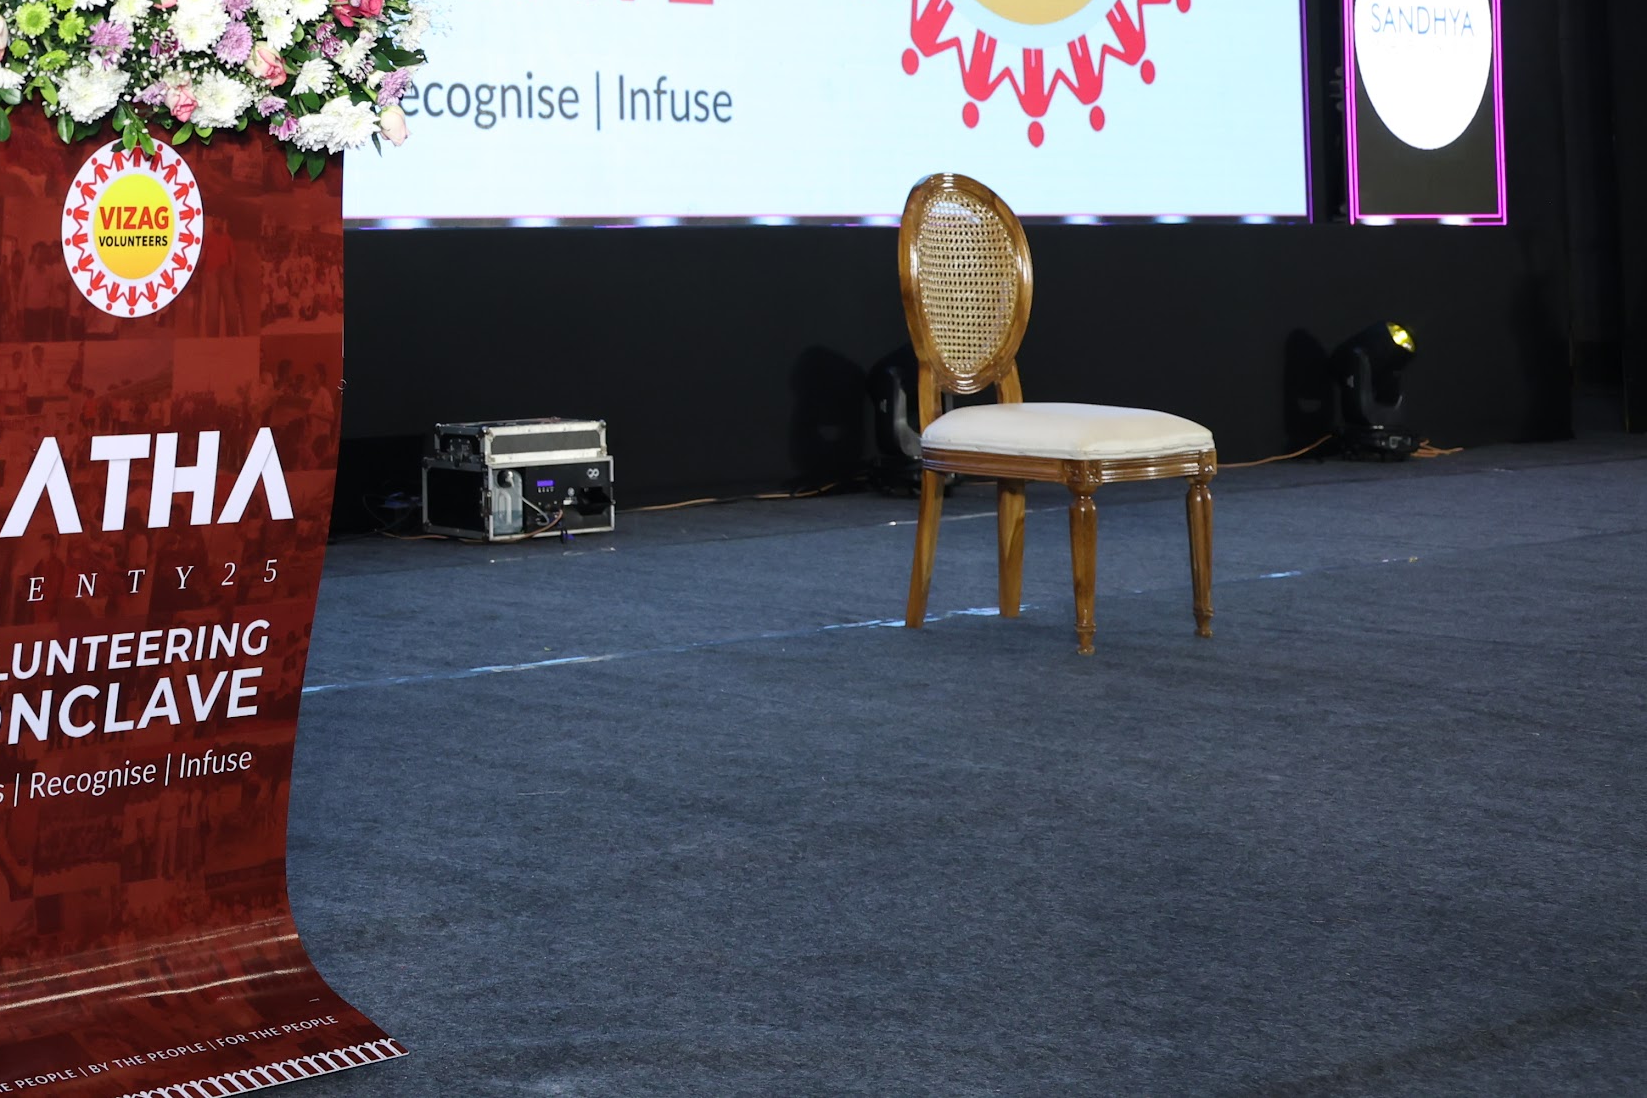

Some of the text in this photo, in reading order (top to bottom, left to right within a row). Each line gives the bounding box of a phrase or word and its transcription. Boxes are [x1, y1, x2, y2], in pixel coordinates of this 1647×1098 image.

[1371, 2, 1475, 37] SANDHYA
[397, 71, 580, 130] ecognise
[618, 76, 733, 124] Infuse
[99, 206, 169, 230] VIZAG
[98, 235, 168, 247] VOLUNTEERS
[29, 761, 157, 799] Recognise
[178, 749, 253, 779] Infuse
[14, 1068, 77, 1089] PEOPLE
[88, 1062, 110, 1074] BY
[111, 1055, 146, 1069] THE
[146, 1042, 206, 1062] PEOPLE
[215, 1034, 249, 1047] FOR
[248, 1027, 282, 1040] THE
[281, 1015, 339, 1034] PEOPLE
